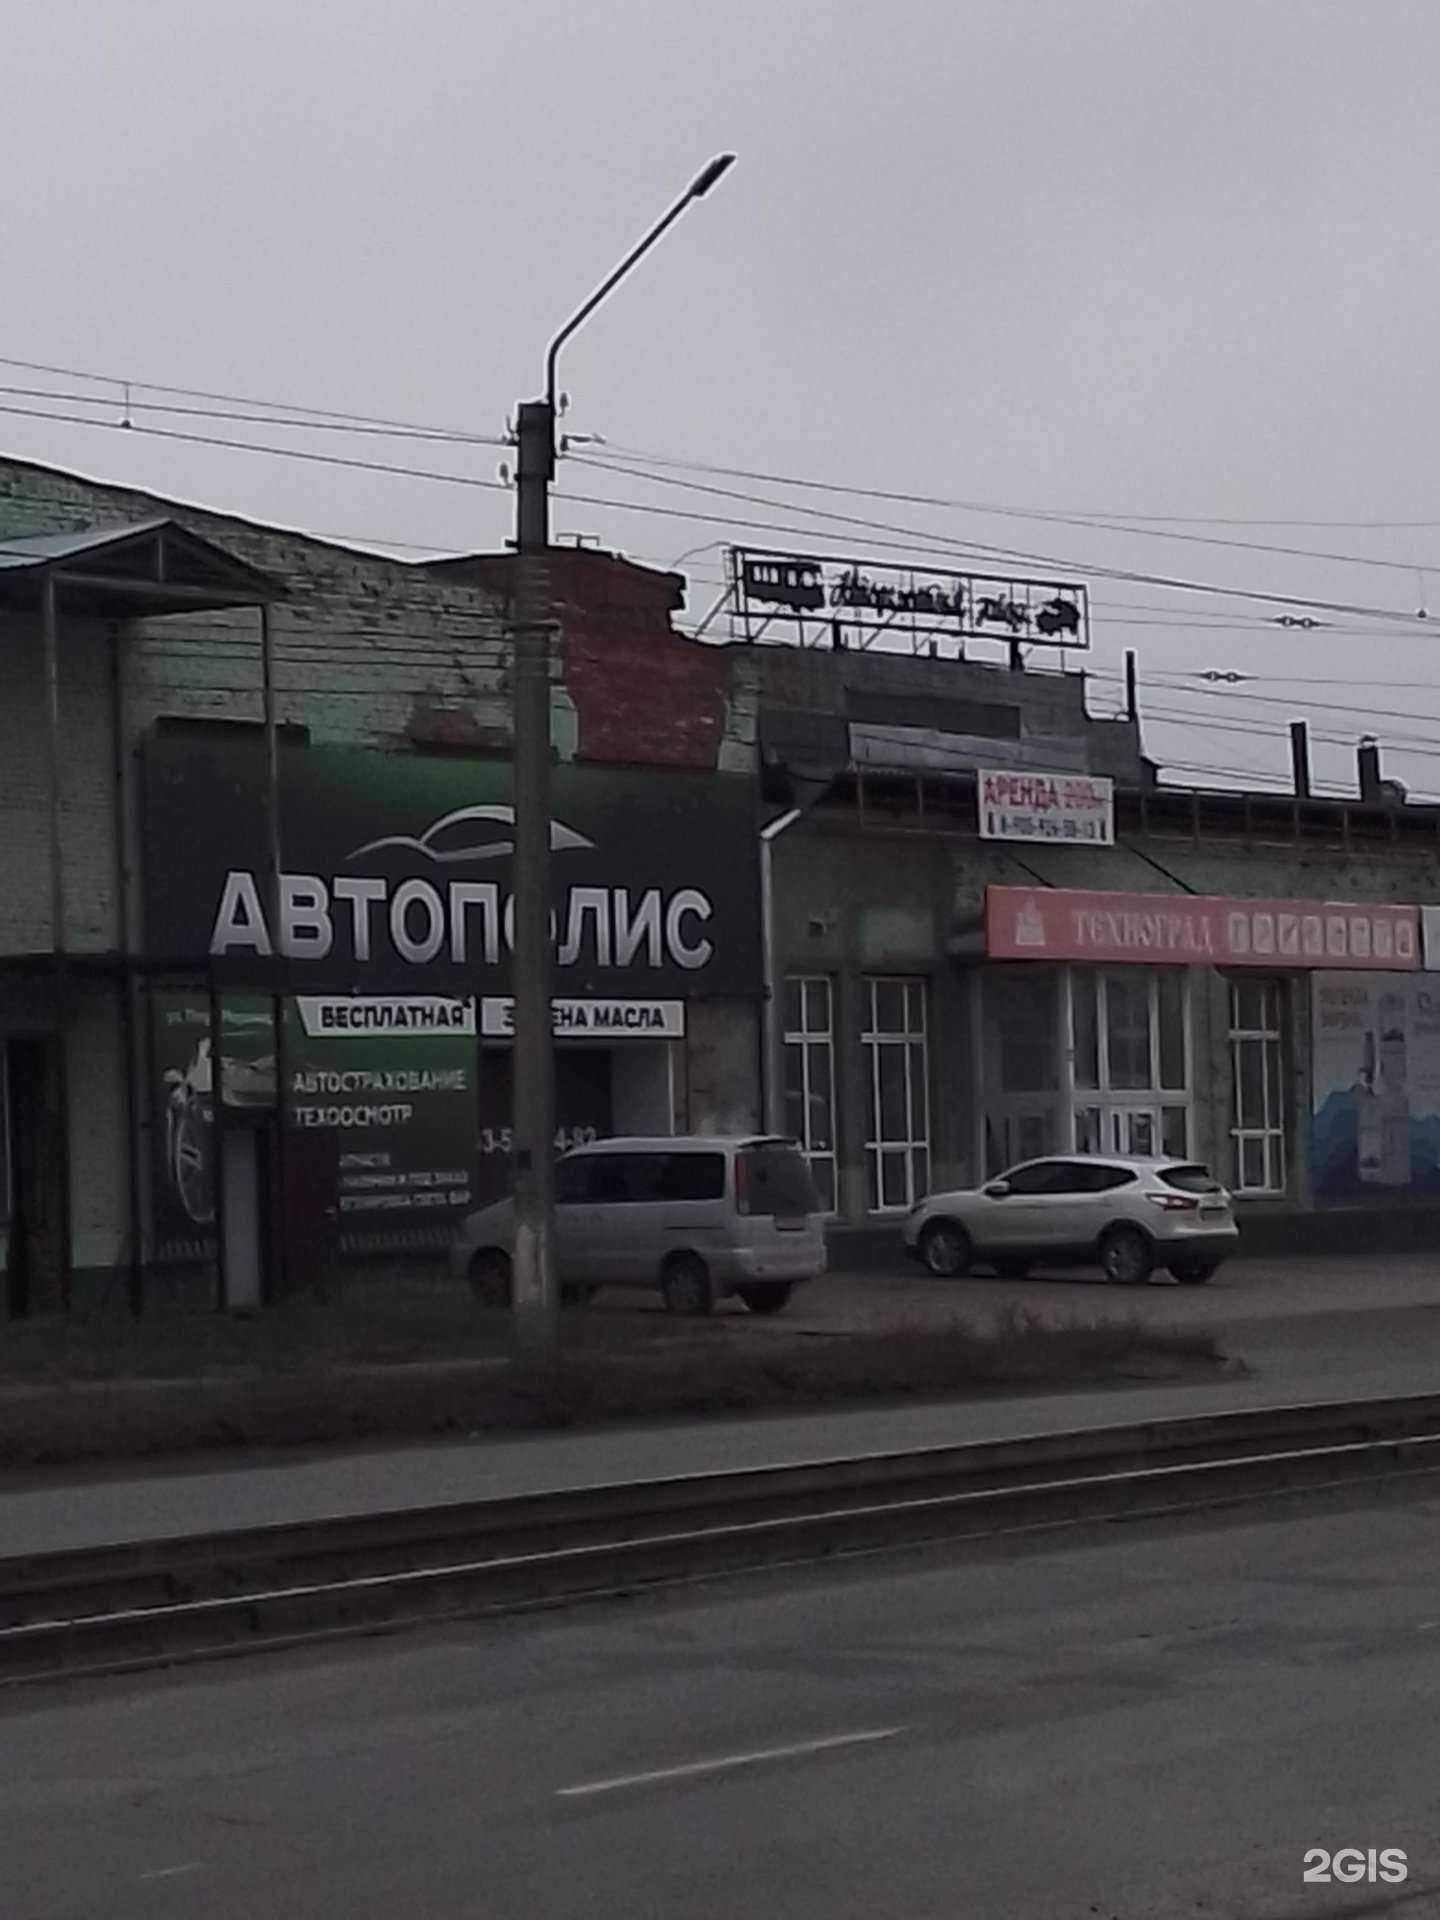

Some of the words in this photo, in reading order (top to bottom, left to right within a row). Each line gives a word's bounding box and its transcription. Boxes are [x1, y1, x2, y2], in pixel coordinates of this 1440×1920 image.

[984, 775, 1059, 813] АРЕНДА
[209, 869, 713, 970] АВТОПЛИС
[320, 1004, 464, 1029] БЕСПЛАТНАЯ
[502, 1005, 588, 1027] ЗЕНА
[592, 1006, 665, 1030] МАСЛА
[292, 1069, 466, 1093] АВТОСТРАХОВАНИЕ
